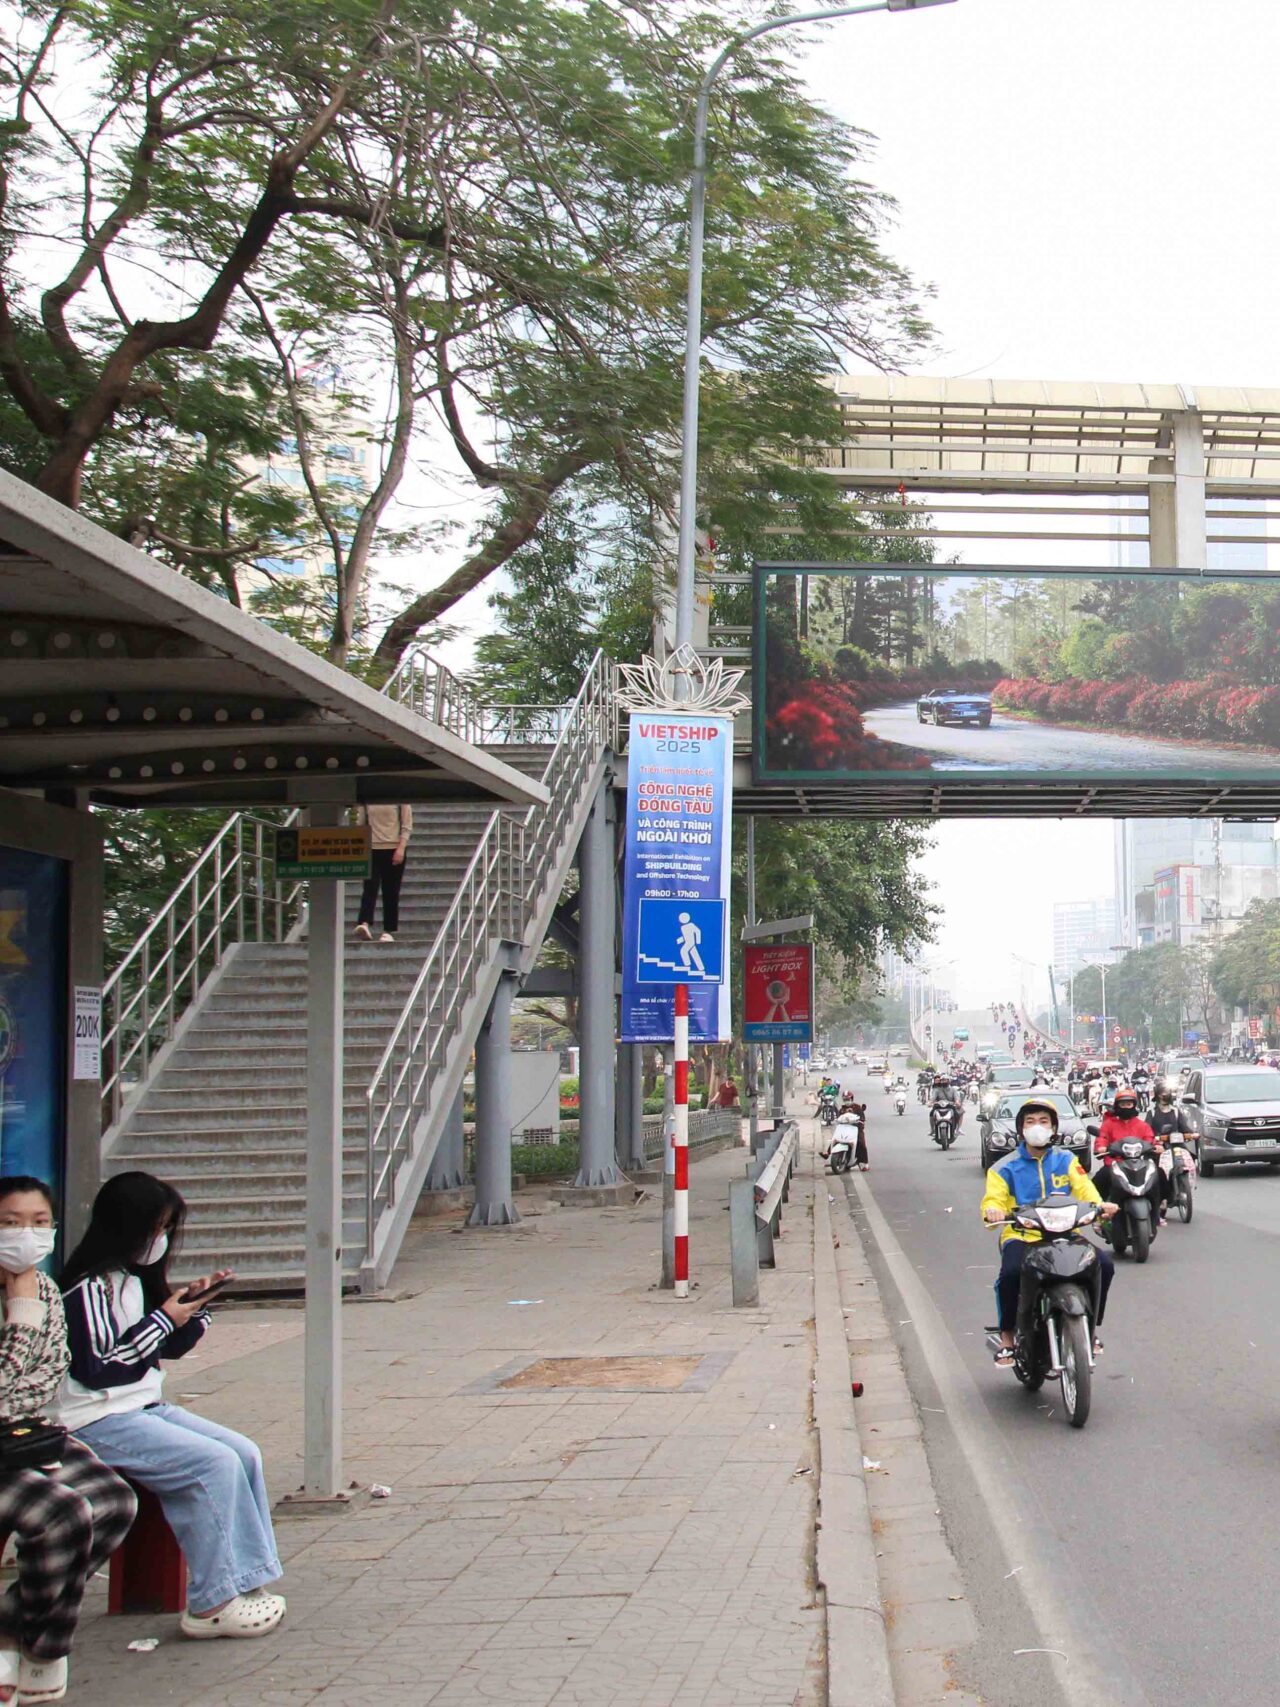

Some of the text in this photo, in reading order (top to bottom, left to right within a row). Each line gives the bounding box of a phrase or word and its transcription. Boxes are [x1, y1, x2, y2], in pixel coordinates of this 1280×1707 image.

[638, 723, 719, 741] VIETSHIP
[656, 740, 701, 754] 2025
[638, 781, 713, 800] CÔNG NGHỆ
[638, 796, 713, 814] ĐÓNG TÀU
[638, 817, 712, 831] VÀ CÔNG TRÌNH
[636, 829, 712, 844] NGOÀI KHƠI
[675, 853, 702, 862] Exhibition
[645, 861, 703, 871] SHIPBUILDING
[676, 873, 710, 882] Technology
[645, 889, 671, 898] 09h00
[677, 889, 700, 898] 17h00
[752, 962, 802, 974] LIGHT BOX
[76, 1014, 100, 1038] 200K
[1051, 1173, 1069, 1188] be
